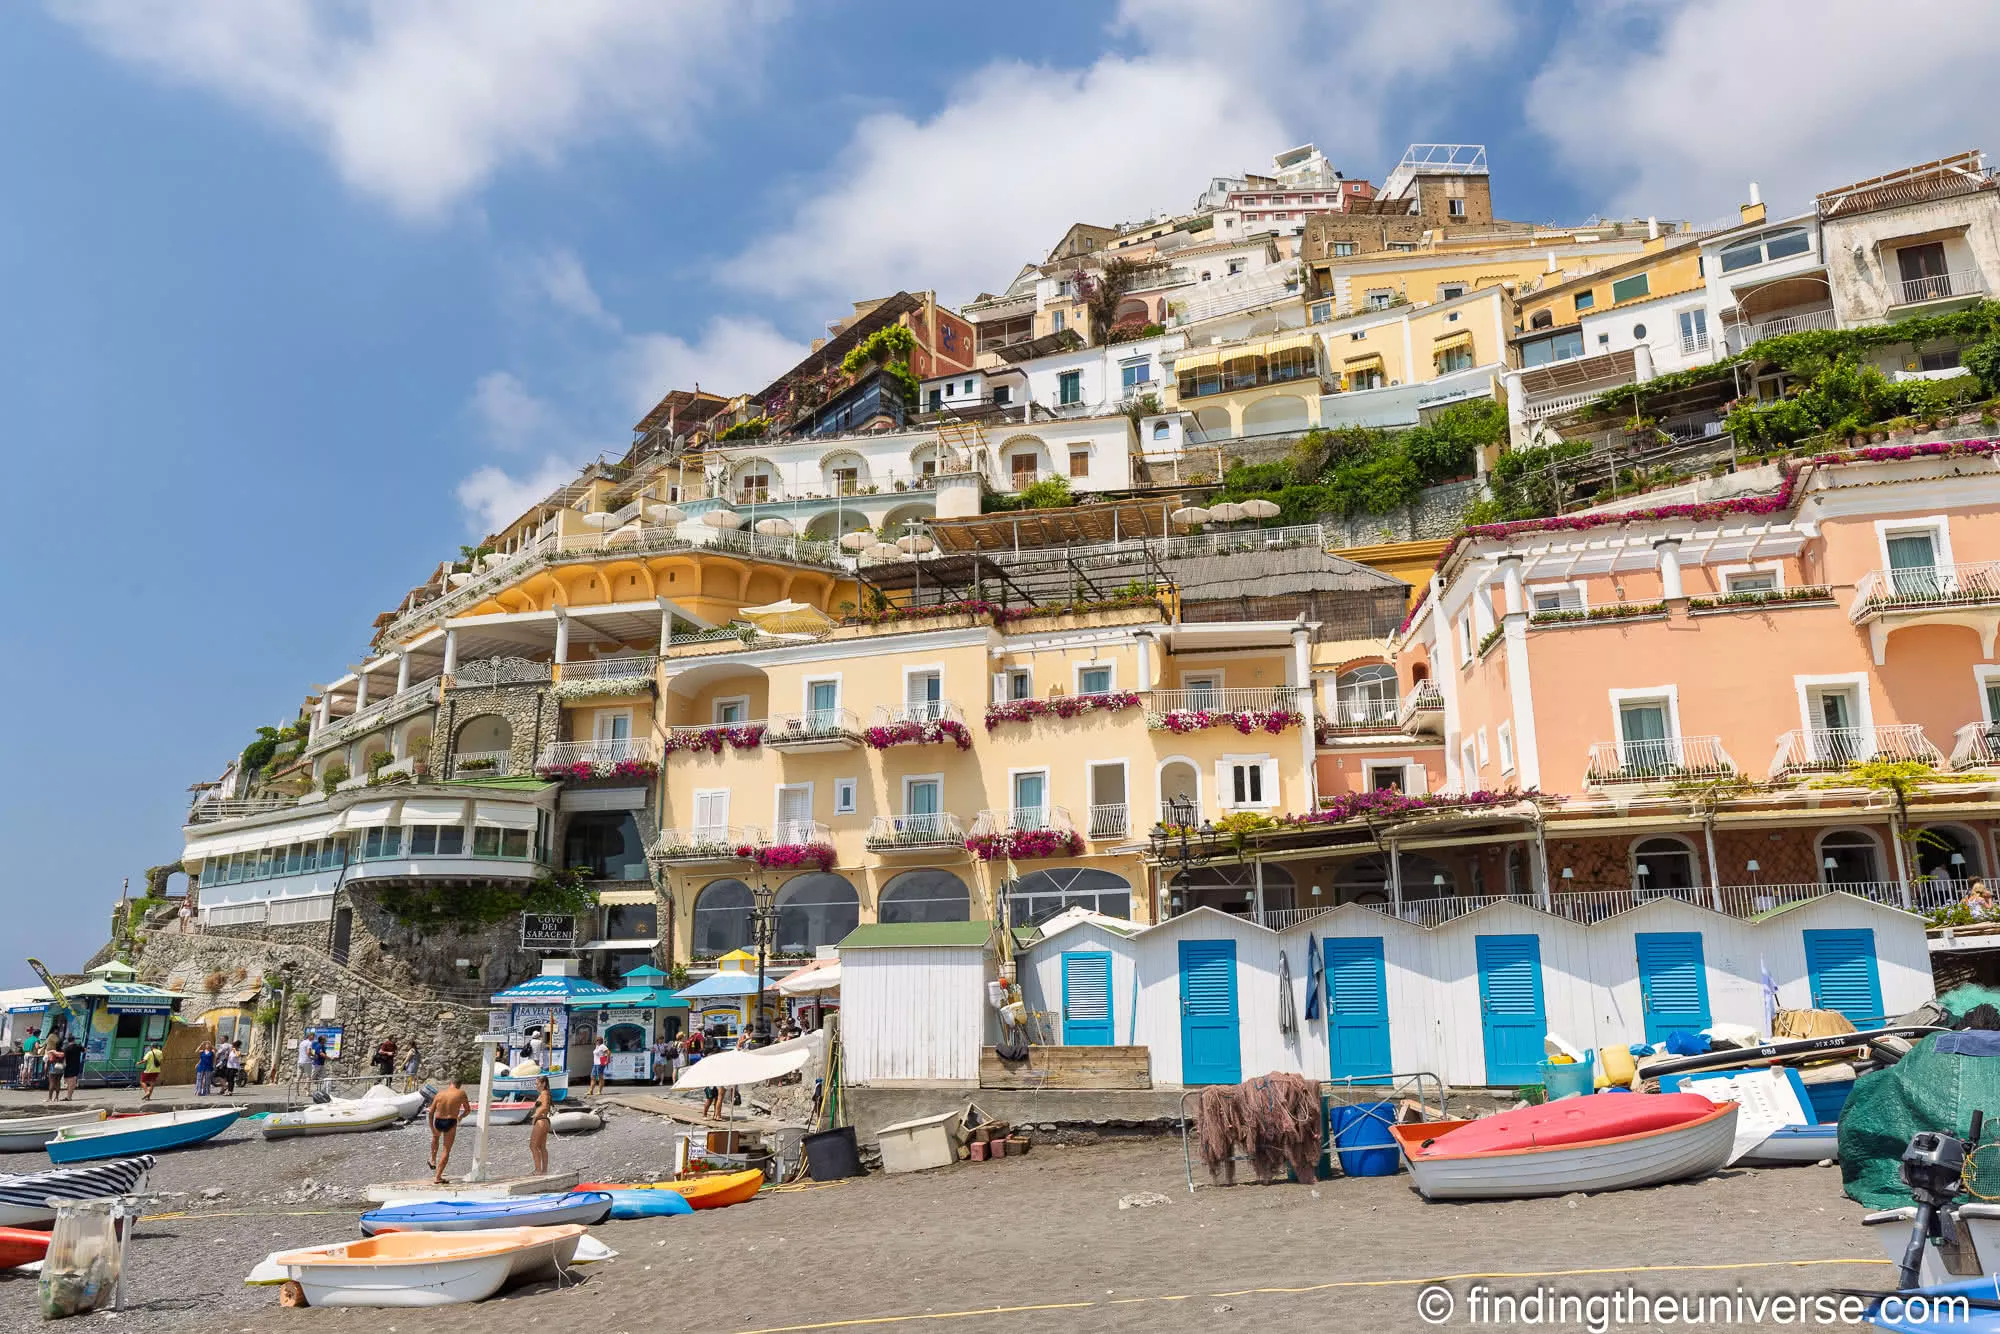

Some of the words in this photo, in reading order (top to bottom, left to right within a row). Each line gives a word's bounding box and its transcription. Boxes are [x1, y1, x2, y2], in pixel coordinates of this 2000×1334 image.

[538, 916, 563, 924] COVO
[542, 923, 557, 931] DEI
[526, 930, 572, 939] SARACENI
[1761, 1047, 1777, 1056] PRO
